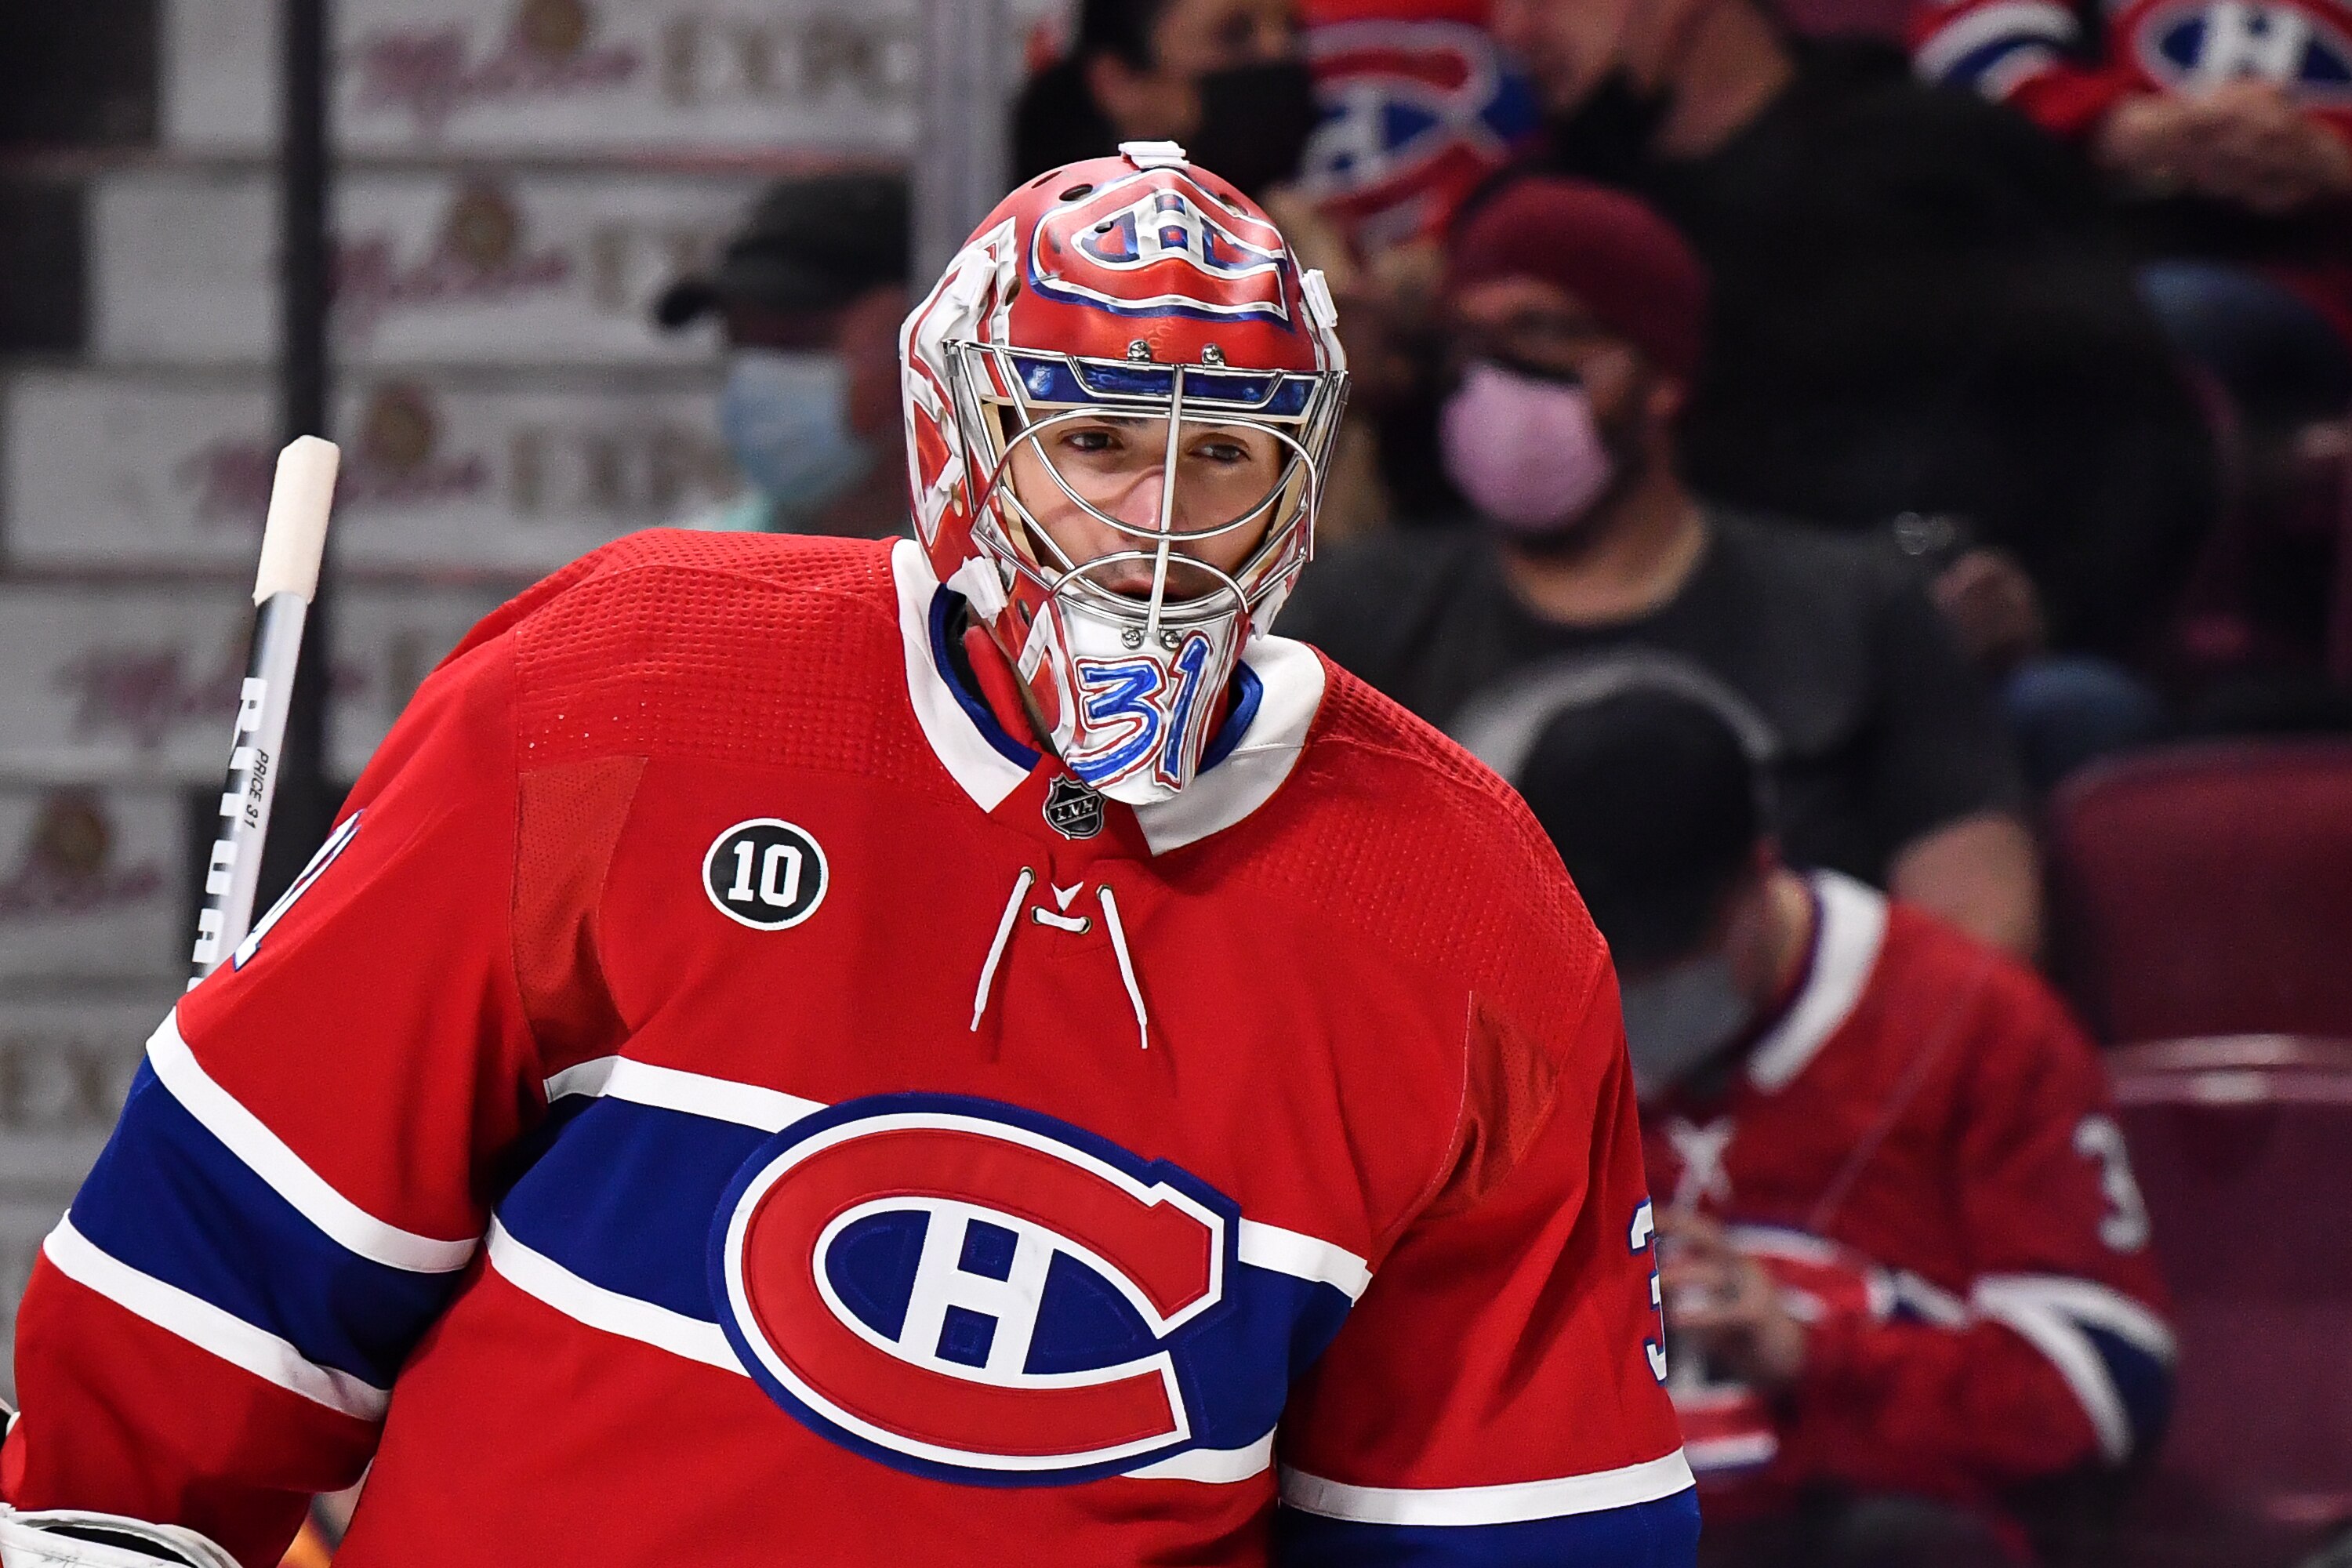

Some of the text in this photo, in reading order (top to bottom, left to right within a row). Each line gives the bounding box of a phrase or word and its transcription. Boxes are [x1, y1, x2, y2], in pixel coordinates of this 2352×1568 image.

[1066, 629, 1214, 792] 31
[187, 677, 268, 993] RITUA
[244, 748, 270, 829] PRICE 31
[727, 840, 803, 908] 10
